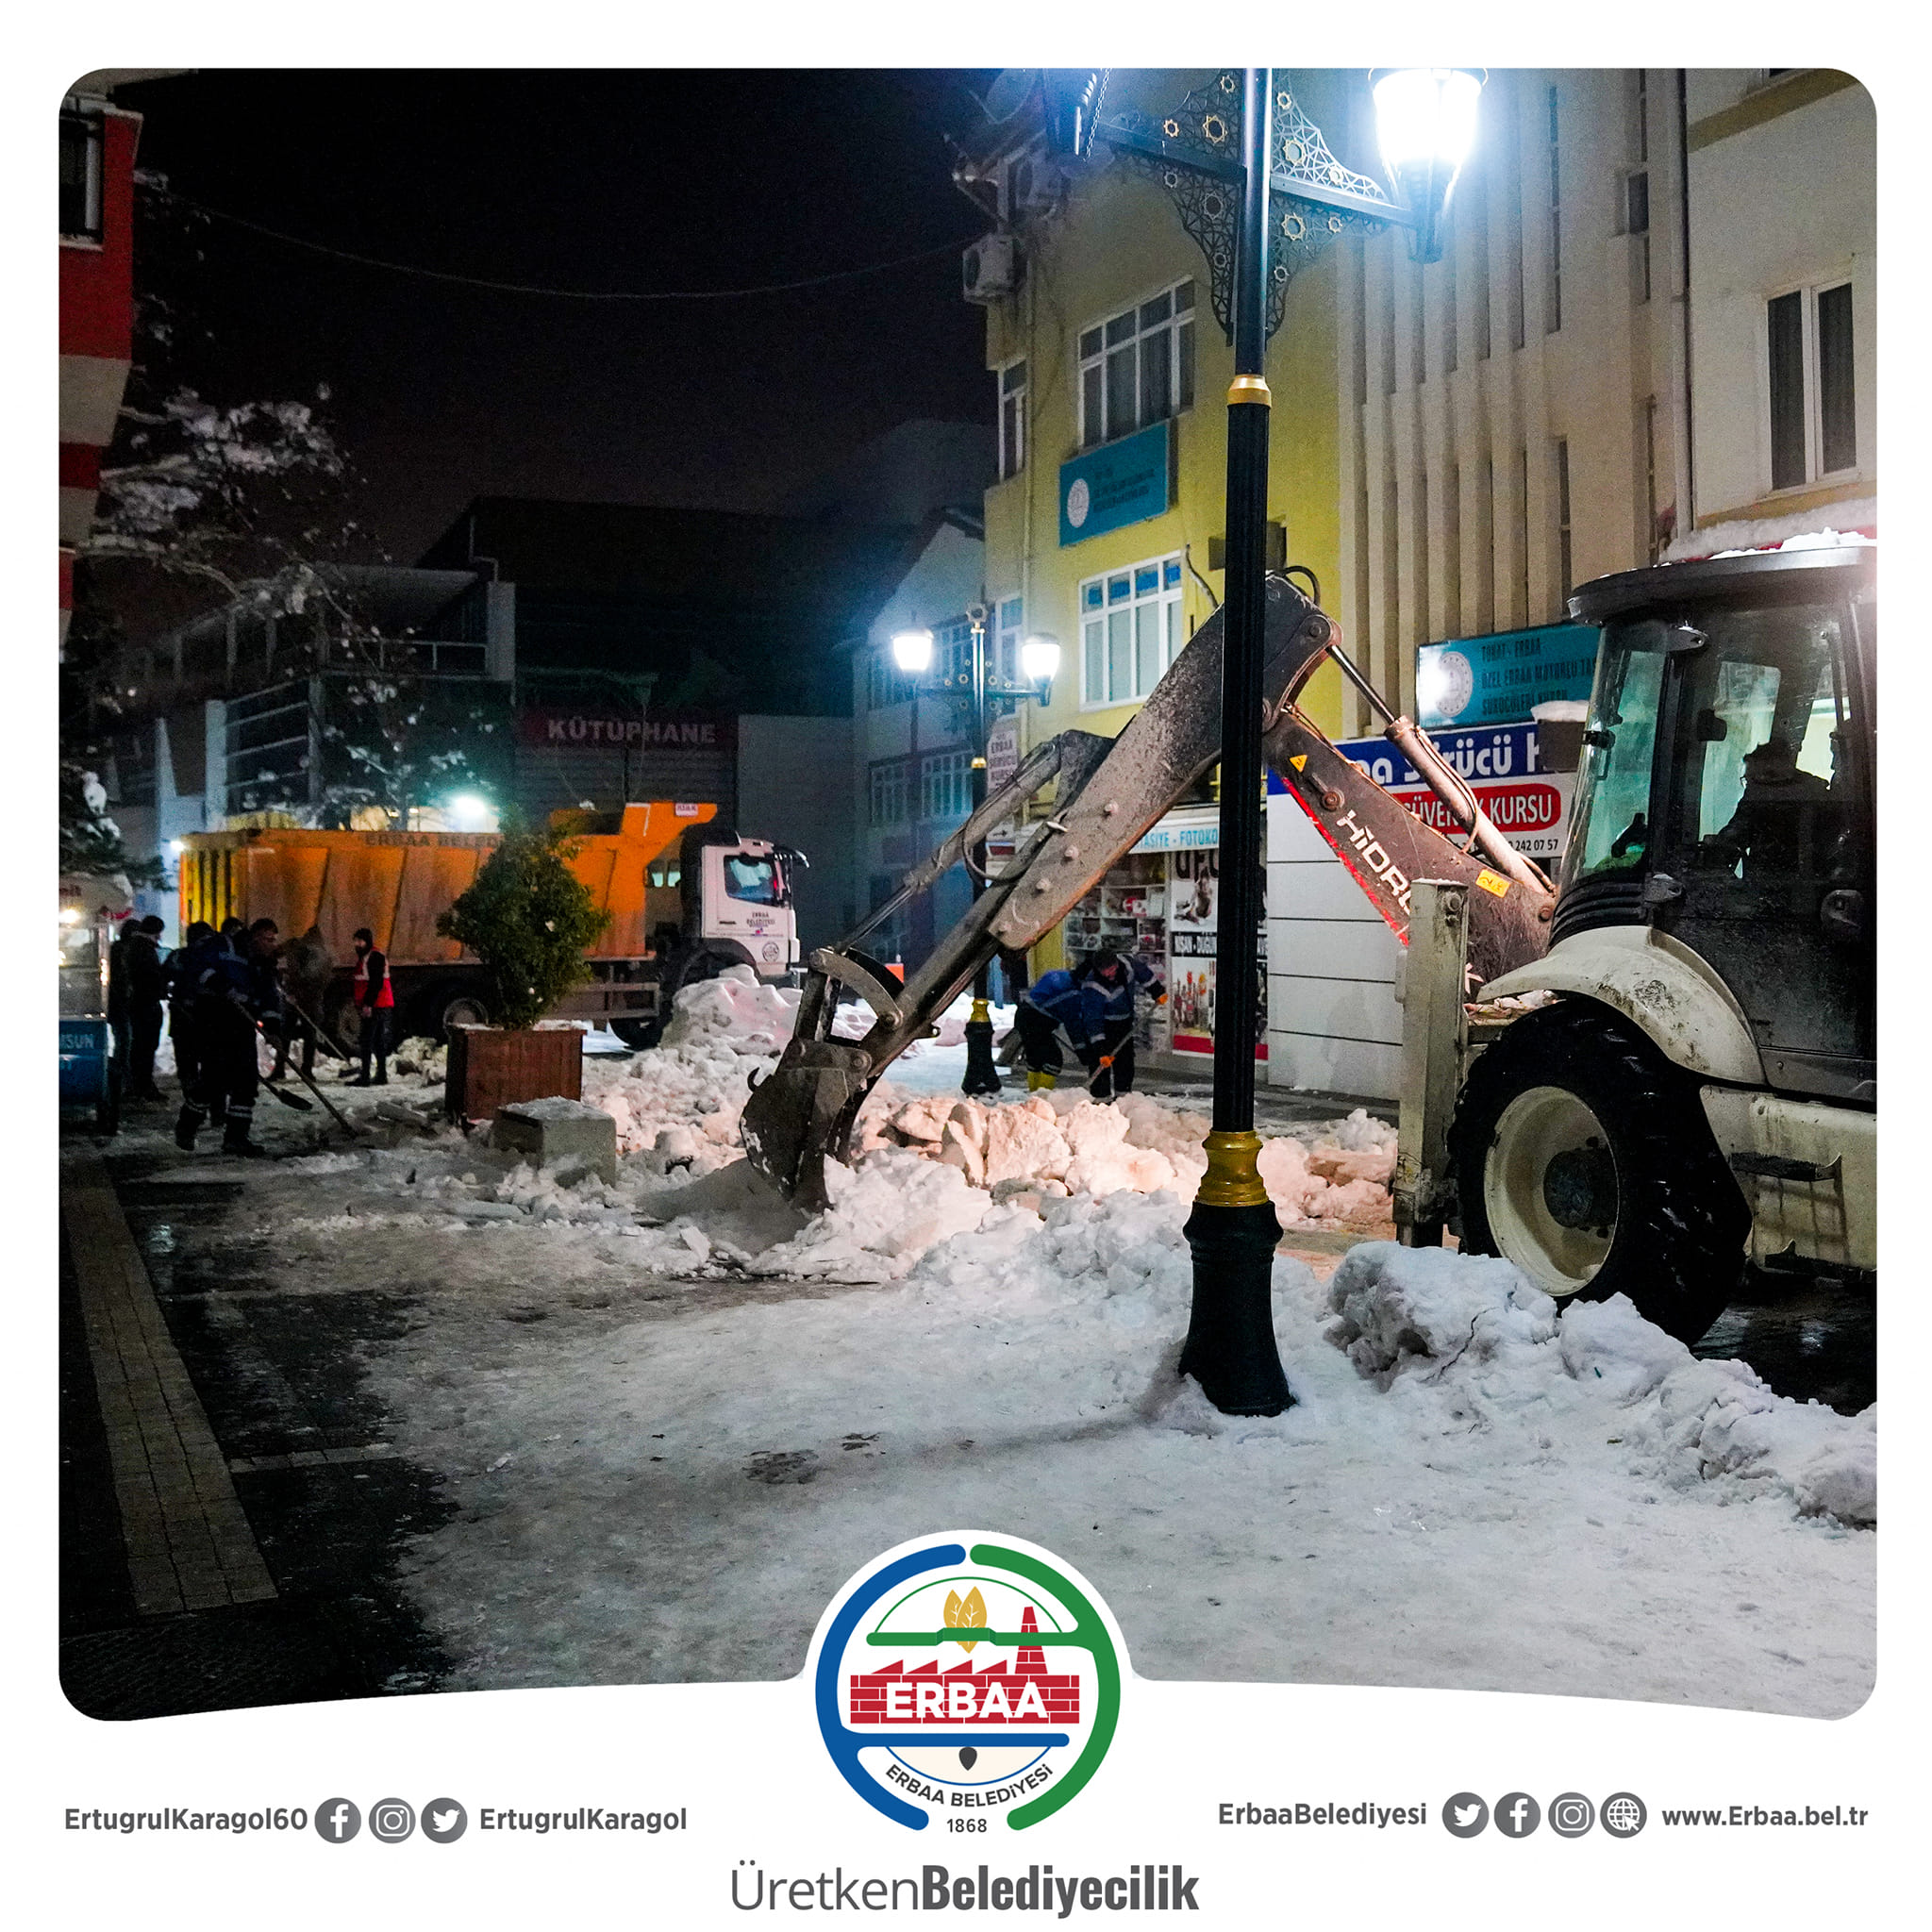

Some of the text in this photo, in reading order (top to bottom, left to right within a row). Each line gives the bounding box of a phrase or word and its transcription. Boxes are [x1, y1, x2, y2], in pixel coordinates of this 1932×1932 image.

[1514, 638, 1541, 658] ERBAA
[1505, 665, 1532, 686] ERBAA
[1404, 733, 1511, 782] rücü
[1490, 794, 1552, 826] KURSU
[1515, 838, 1558, 851] 242 07 57
